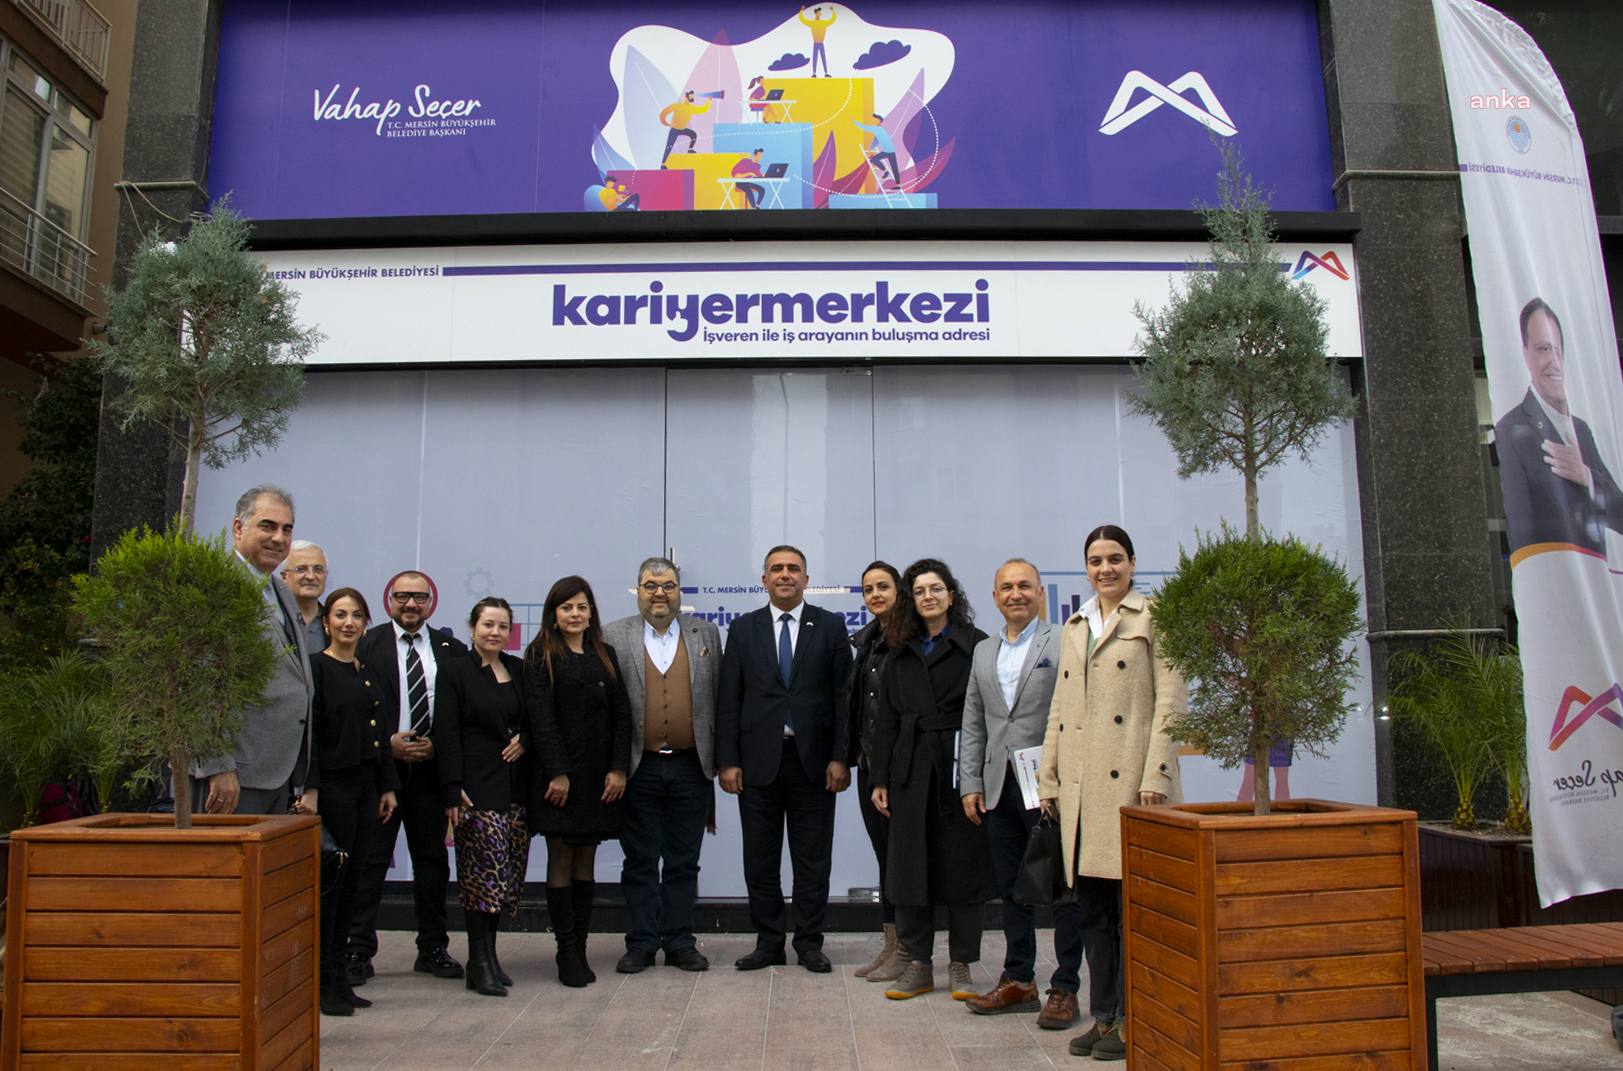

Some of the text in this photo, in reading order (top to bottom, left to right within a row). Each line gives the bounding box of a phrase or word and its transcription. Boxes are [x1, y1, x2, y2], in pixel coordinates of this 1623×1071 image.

[314, 84, 481, 136] Vahap Seçer
[387, 117, 497, 129] T.C. MERSİN BÜYÜKŞEHİR
[387, 128, 466, 138] BELEDİYE BAŞKANI
[309, 266, 378, 280] BÜYÜKŞEHİR
[381, 265, 439, 277] BELEDİYESİ
[552, 278, 990, 342] kariyermerkezi
[703, 326, 990, 345] İşveren ile iş arayanın buluşma adresi
[703, 586, 716, 594] T.C.
[717, 585, 747, 594] MERSİN
